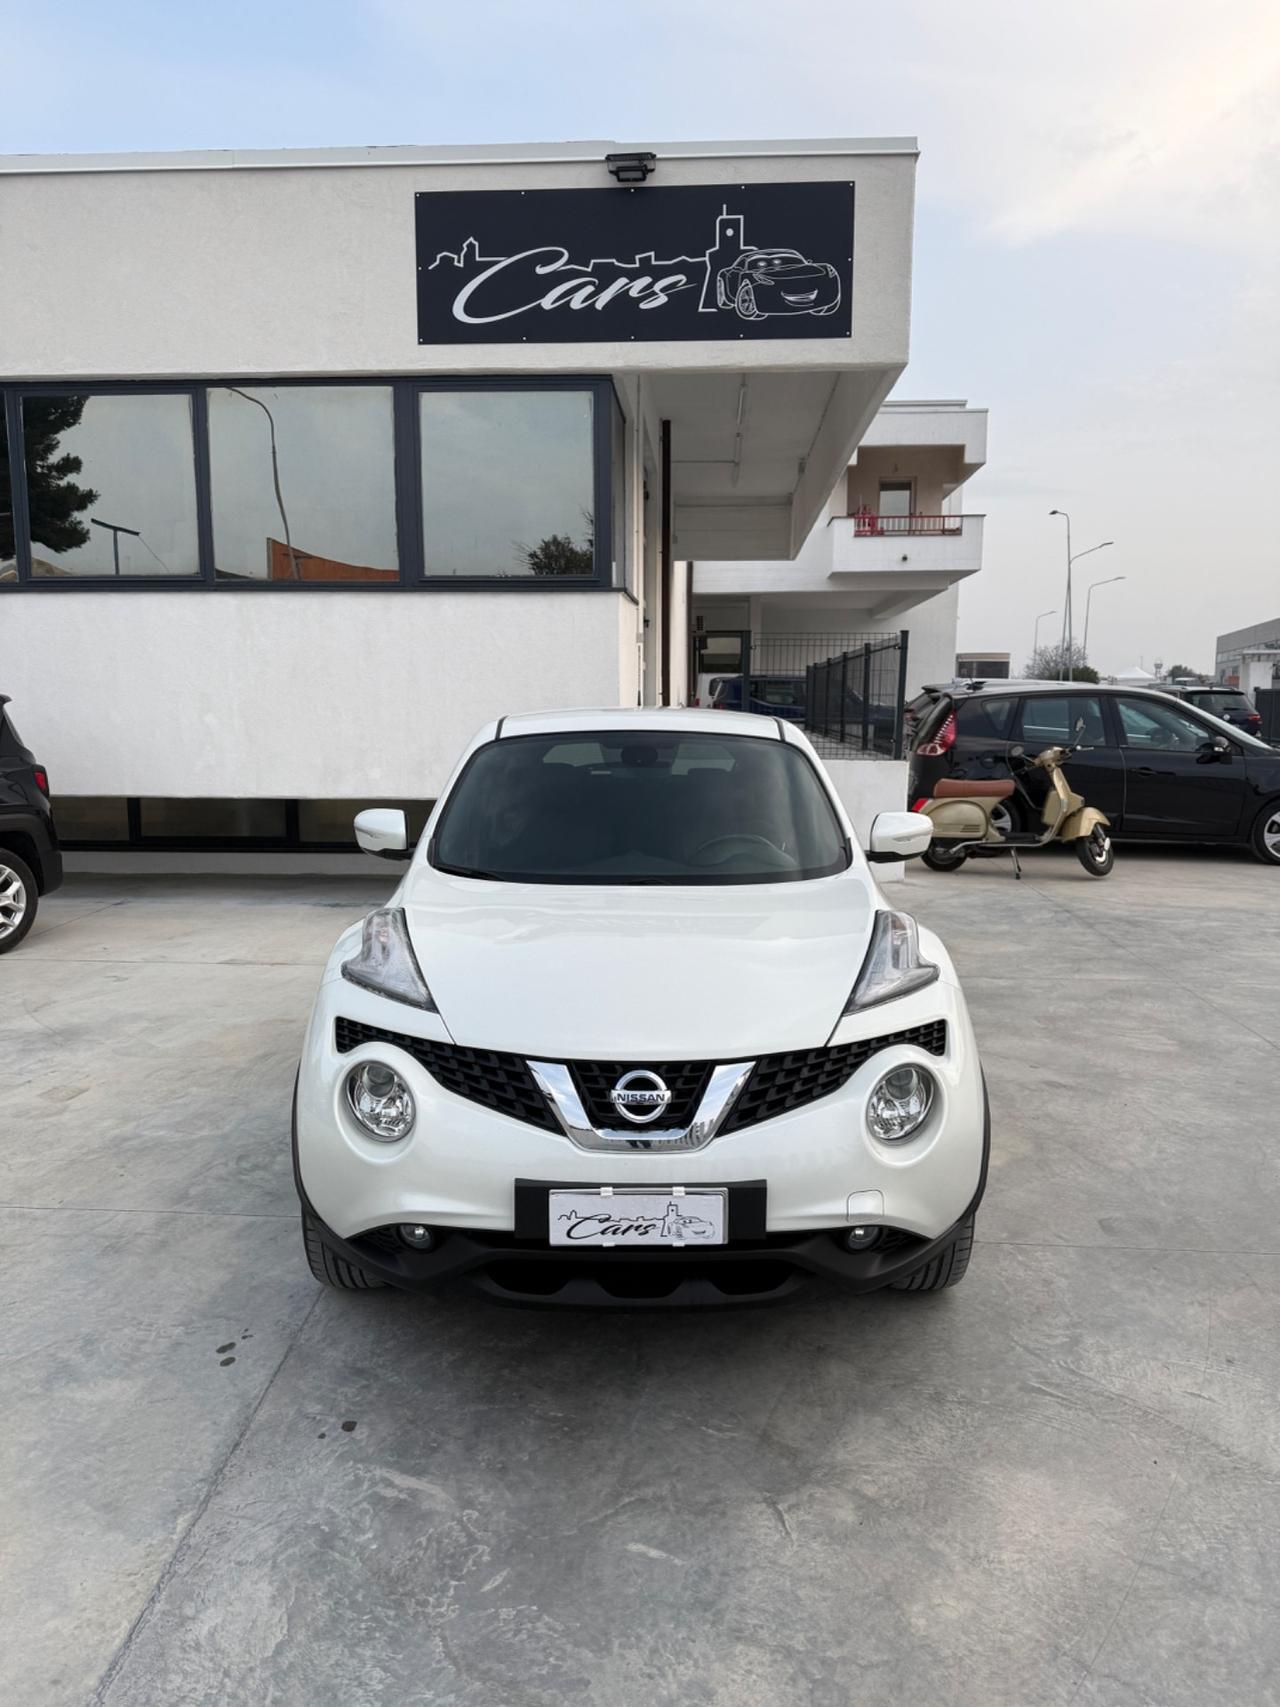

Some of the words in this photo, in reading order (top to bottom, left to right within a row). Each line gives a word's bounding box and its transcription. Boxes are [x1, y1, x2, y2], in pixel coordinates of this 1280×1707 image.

[452, 246, 698, 324] Cars
[616, 1092, 666, 1103] NISSAN
[566, 1213, 657, 1240] Cars
